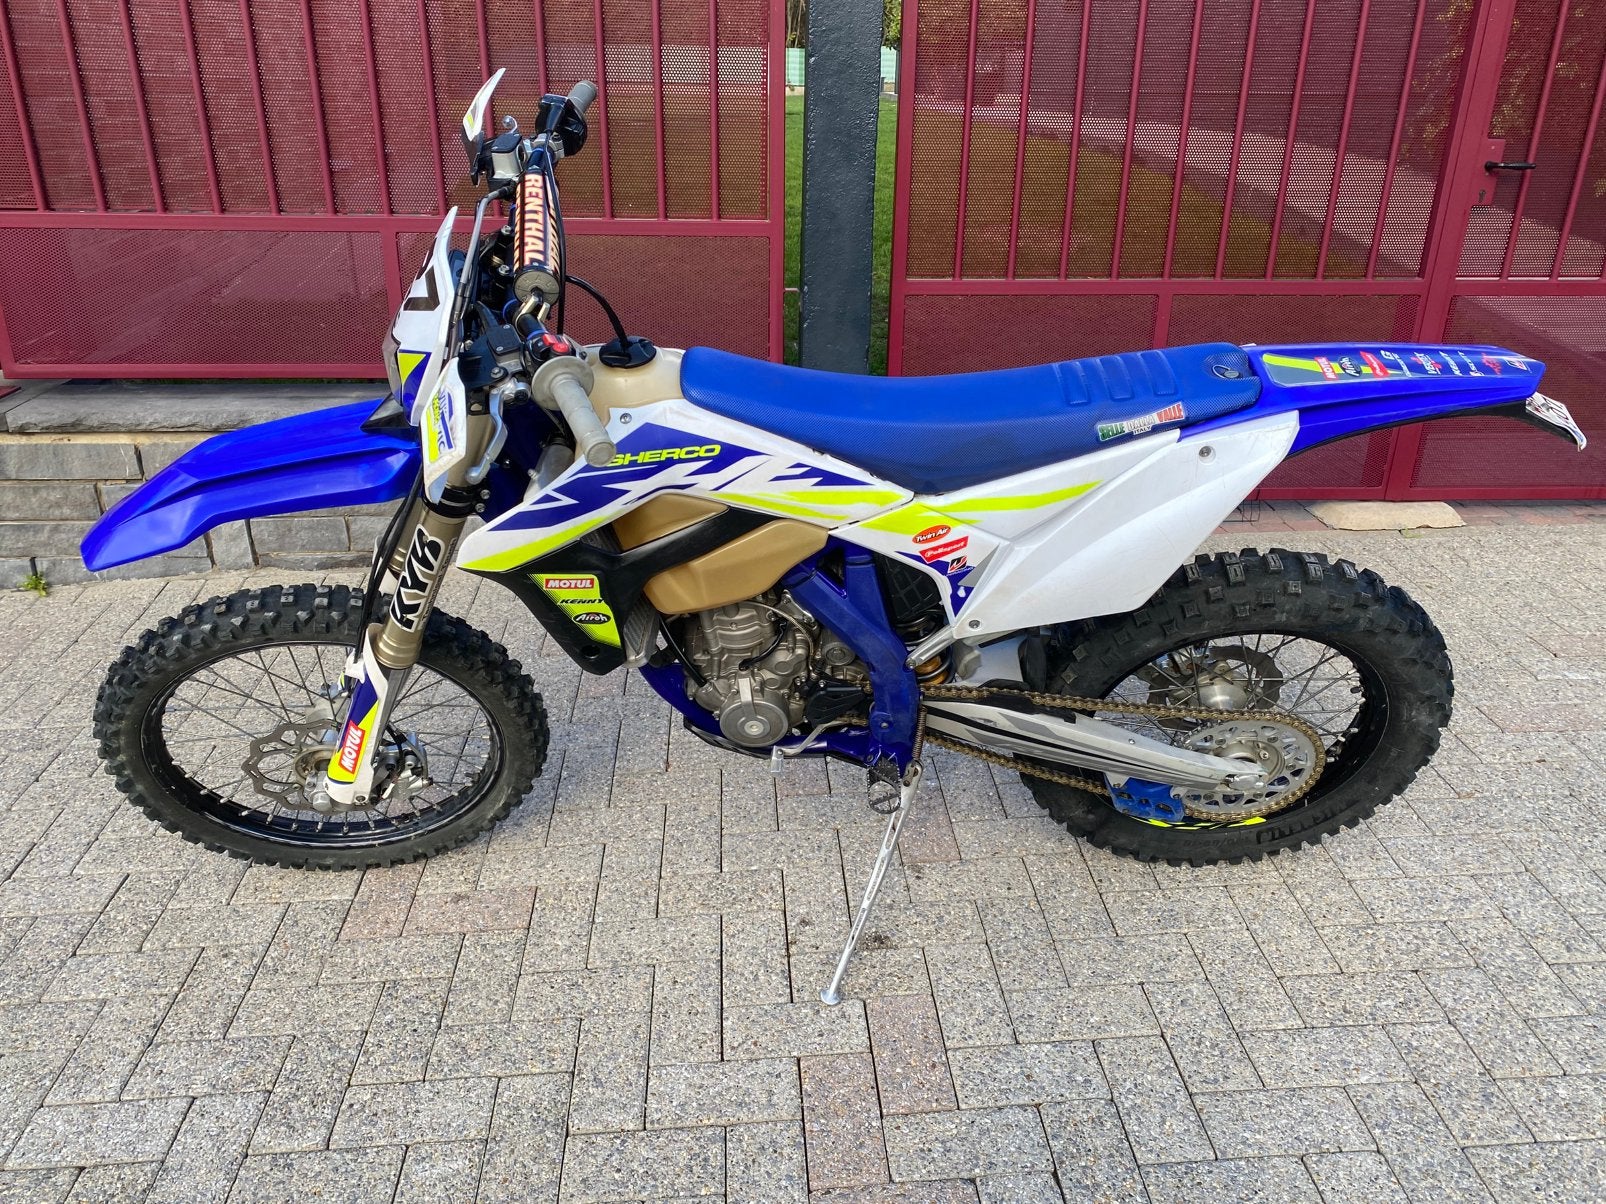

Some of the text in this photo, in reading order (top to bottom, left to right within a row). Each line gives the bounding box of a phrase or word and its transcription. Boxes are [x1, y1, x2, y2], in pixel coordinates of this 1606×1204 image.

[524, 173, 545, 266] RENTHAL
[1099, 422, 1126, 441] SELLE
[1133, 425, 1152, 435] ITALY
[606, 444, 722, 467] SHERCO
[916, 527, 949, 543] Twin Air
[390, 524, 445, 632] KYB
[547, 579, 593, 588] MOTUL
[575, 613, 608, 622] Airoh
[340, 726, 363, 772] MOTUL
